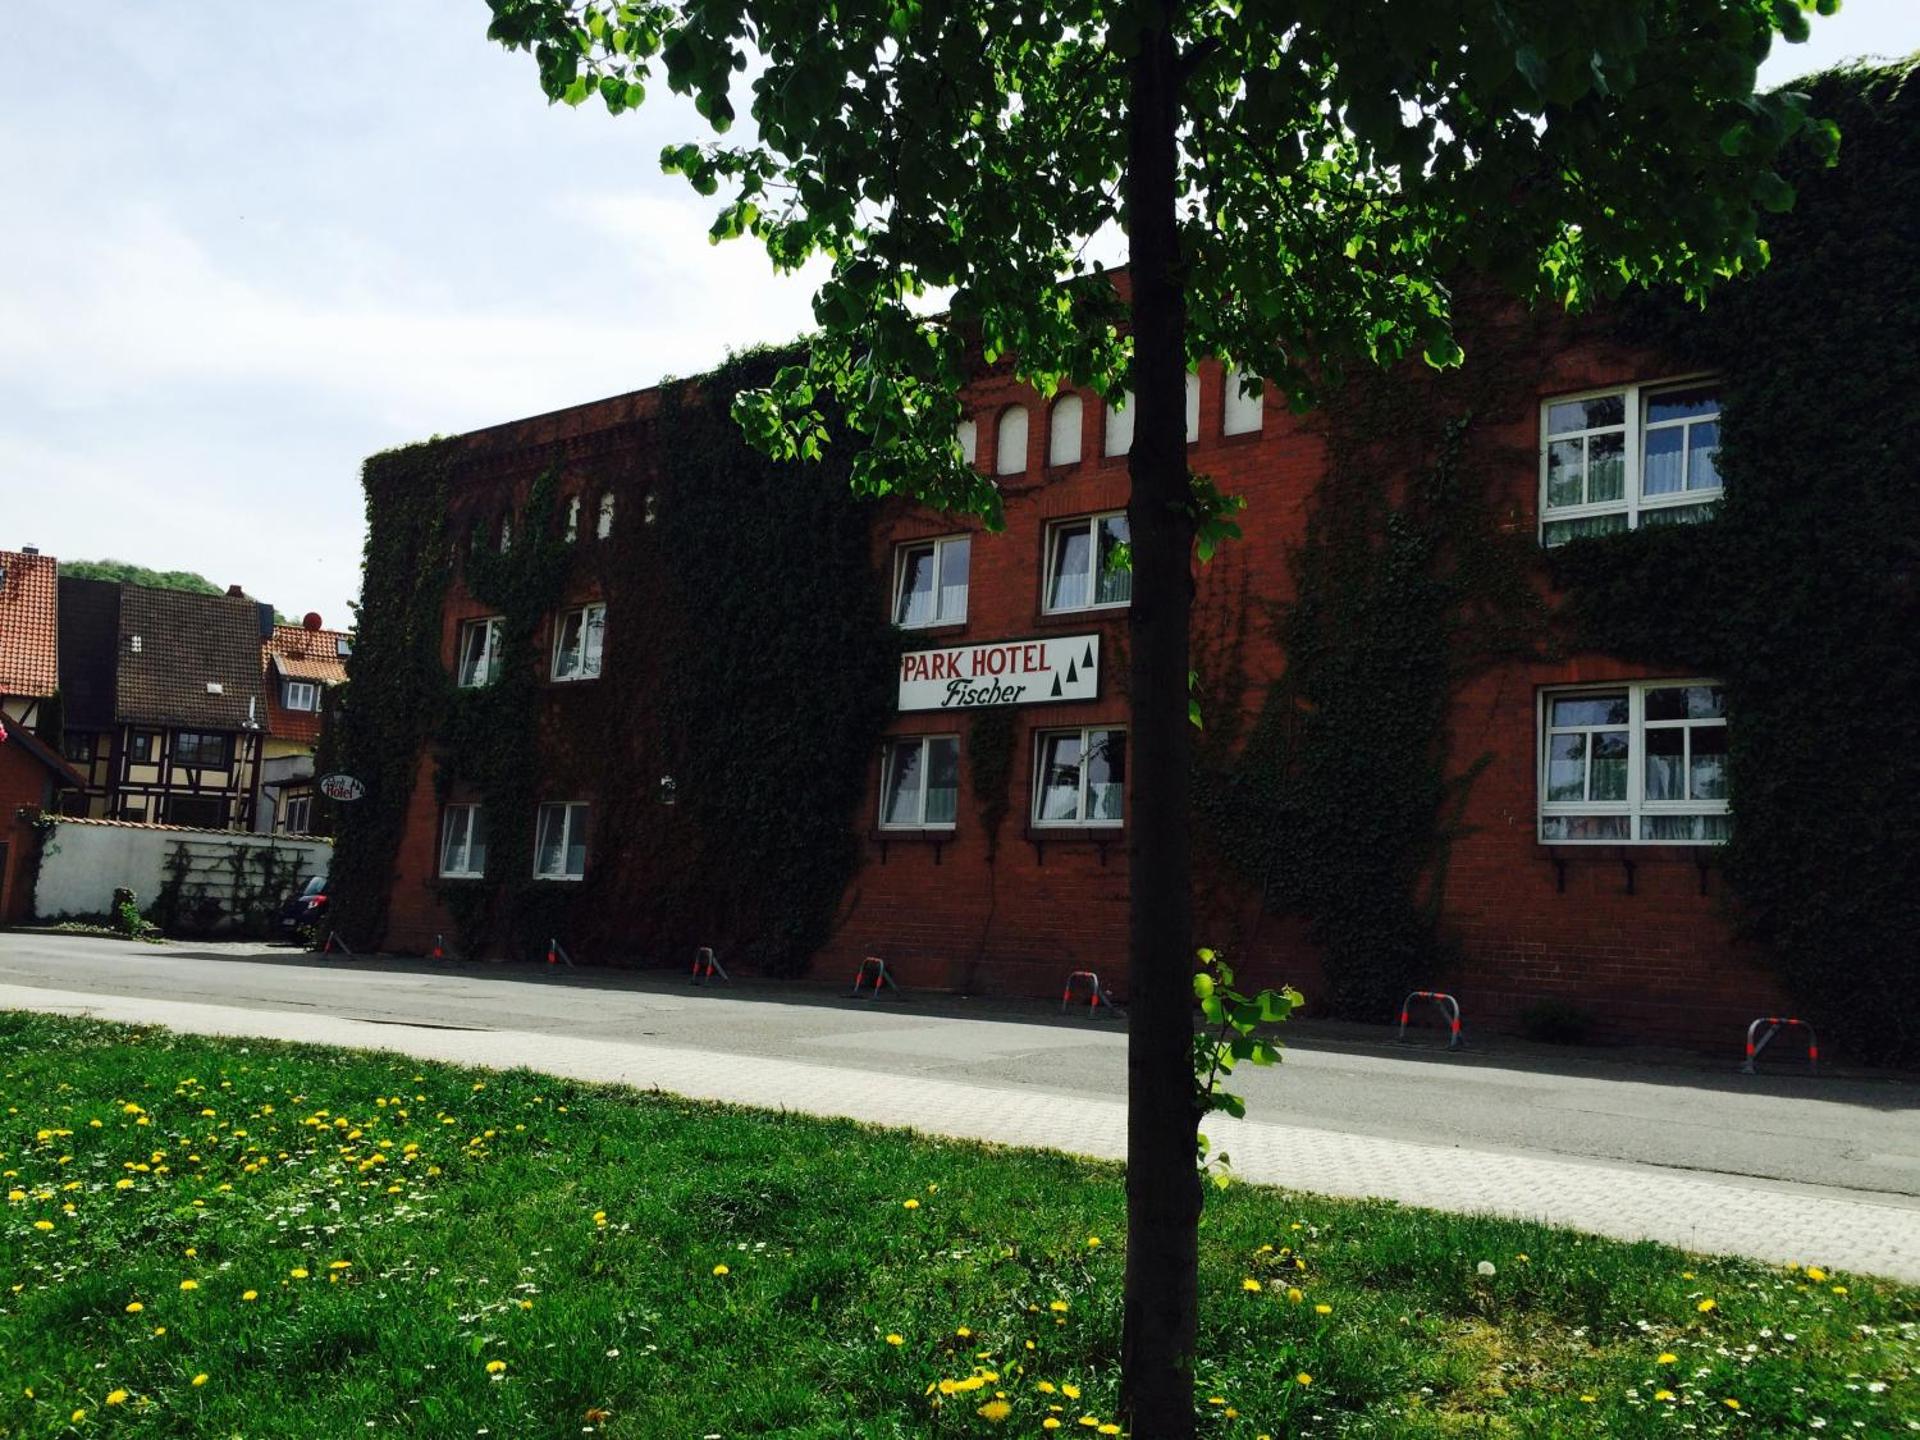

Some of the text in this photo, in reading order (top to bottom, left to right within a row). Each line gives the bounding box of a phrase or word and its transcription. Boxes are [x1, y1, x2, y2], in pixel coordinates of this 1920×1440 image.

[903, 643, 1052, 682] PARK HOTEL
[941, 677, 1026, 707] Fischer
